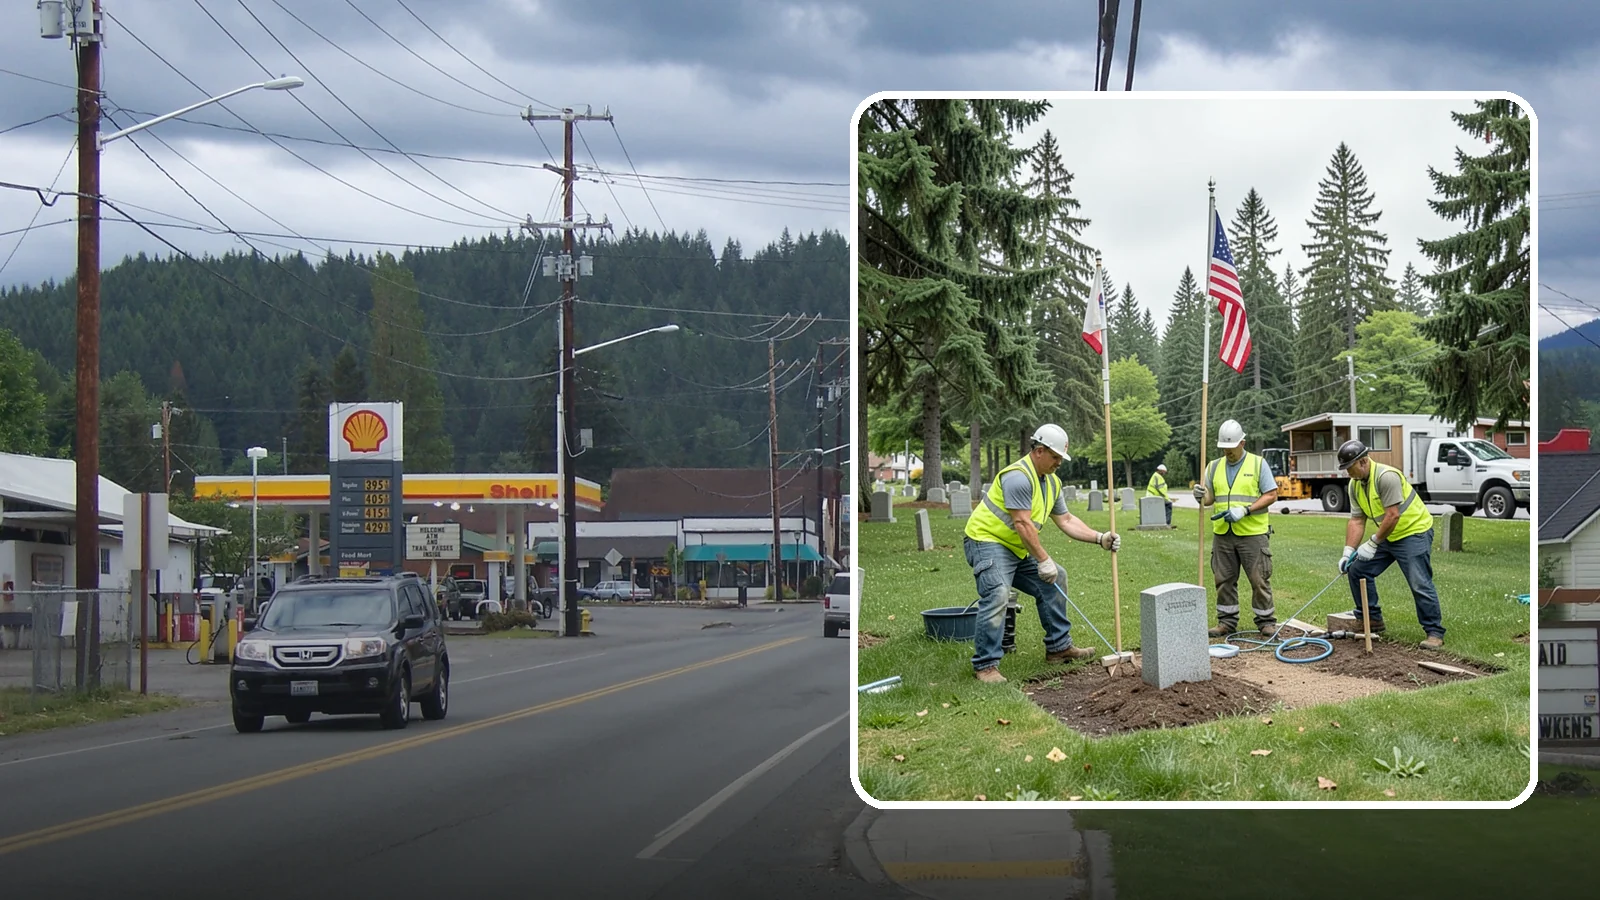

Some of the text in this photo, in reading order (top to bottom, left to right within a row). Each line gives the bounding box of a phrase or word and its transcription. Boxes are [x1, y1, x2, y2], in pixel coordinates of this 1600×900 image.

[366, 479, 383, 490] 395
[490, 484, 547, 499] Shell
[366, 493, 383, 504] 405
[366, 507, 383, 518] 415
[366, 522, 383, 533] 429
